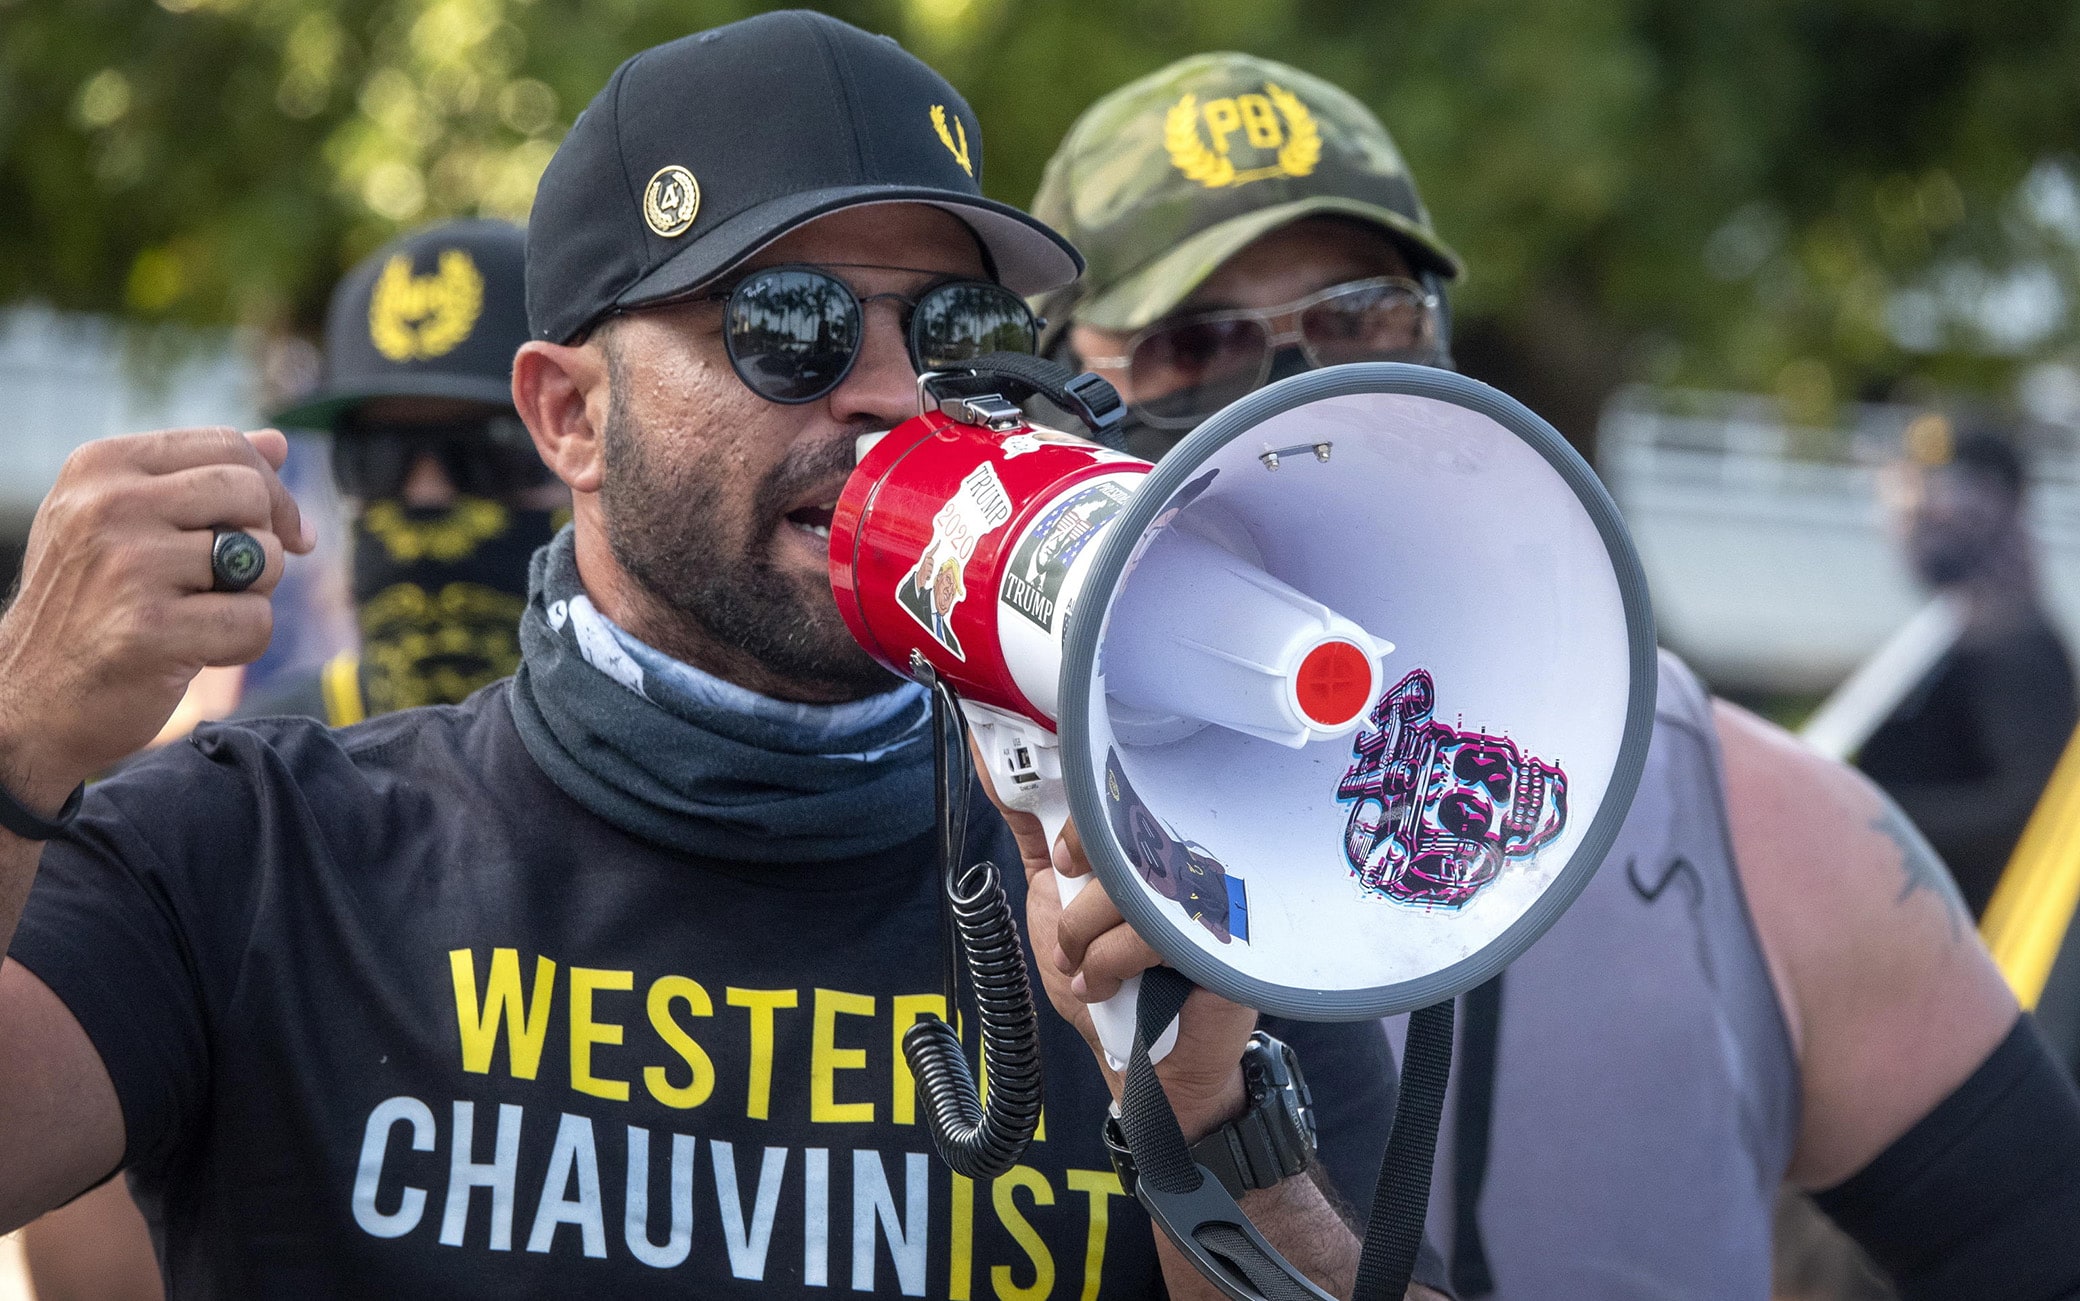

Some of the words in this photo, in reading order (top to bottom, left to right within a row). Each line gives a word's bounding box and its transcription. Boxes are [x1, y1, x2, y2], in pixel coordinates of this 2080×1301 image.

[1202, 93, 1283, 153] PB
[966, 465, 1008, 525] TRUMP
[937, 503, 974, 560] 2020
[1005, 572, 1054, 625] TRUMP
[449, 948, 1046, 1142] WESTER
[351, 1096, 1127, 1301] CHAUVINIST
